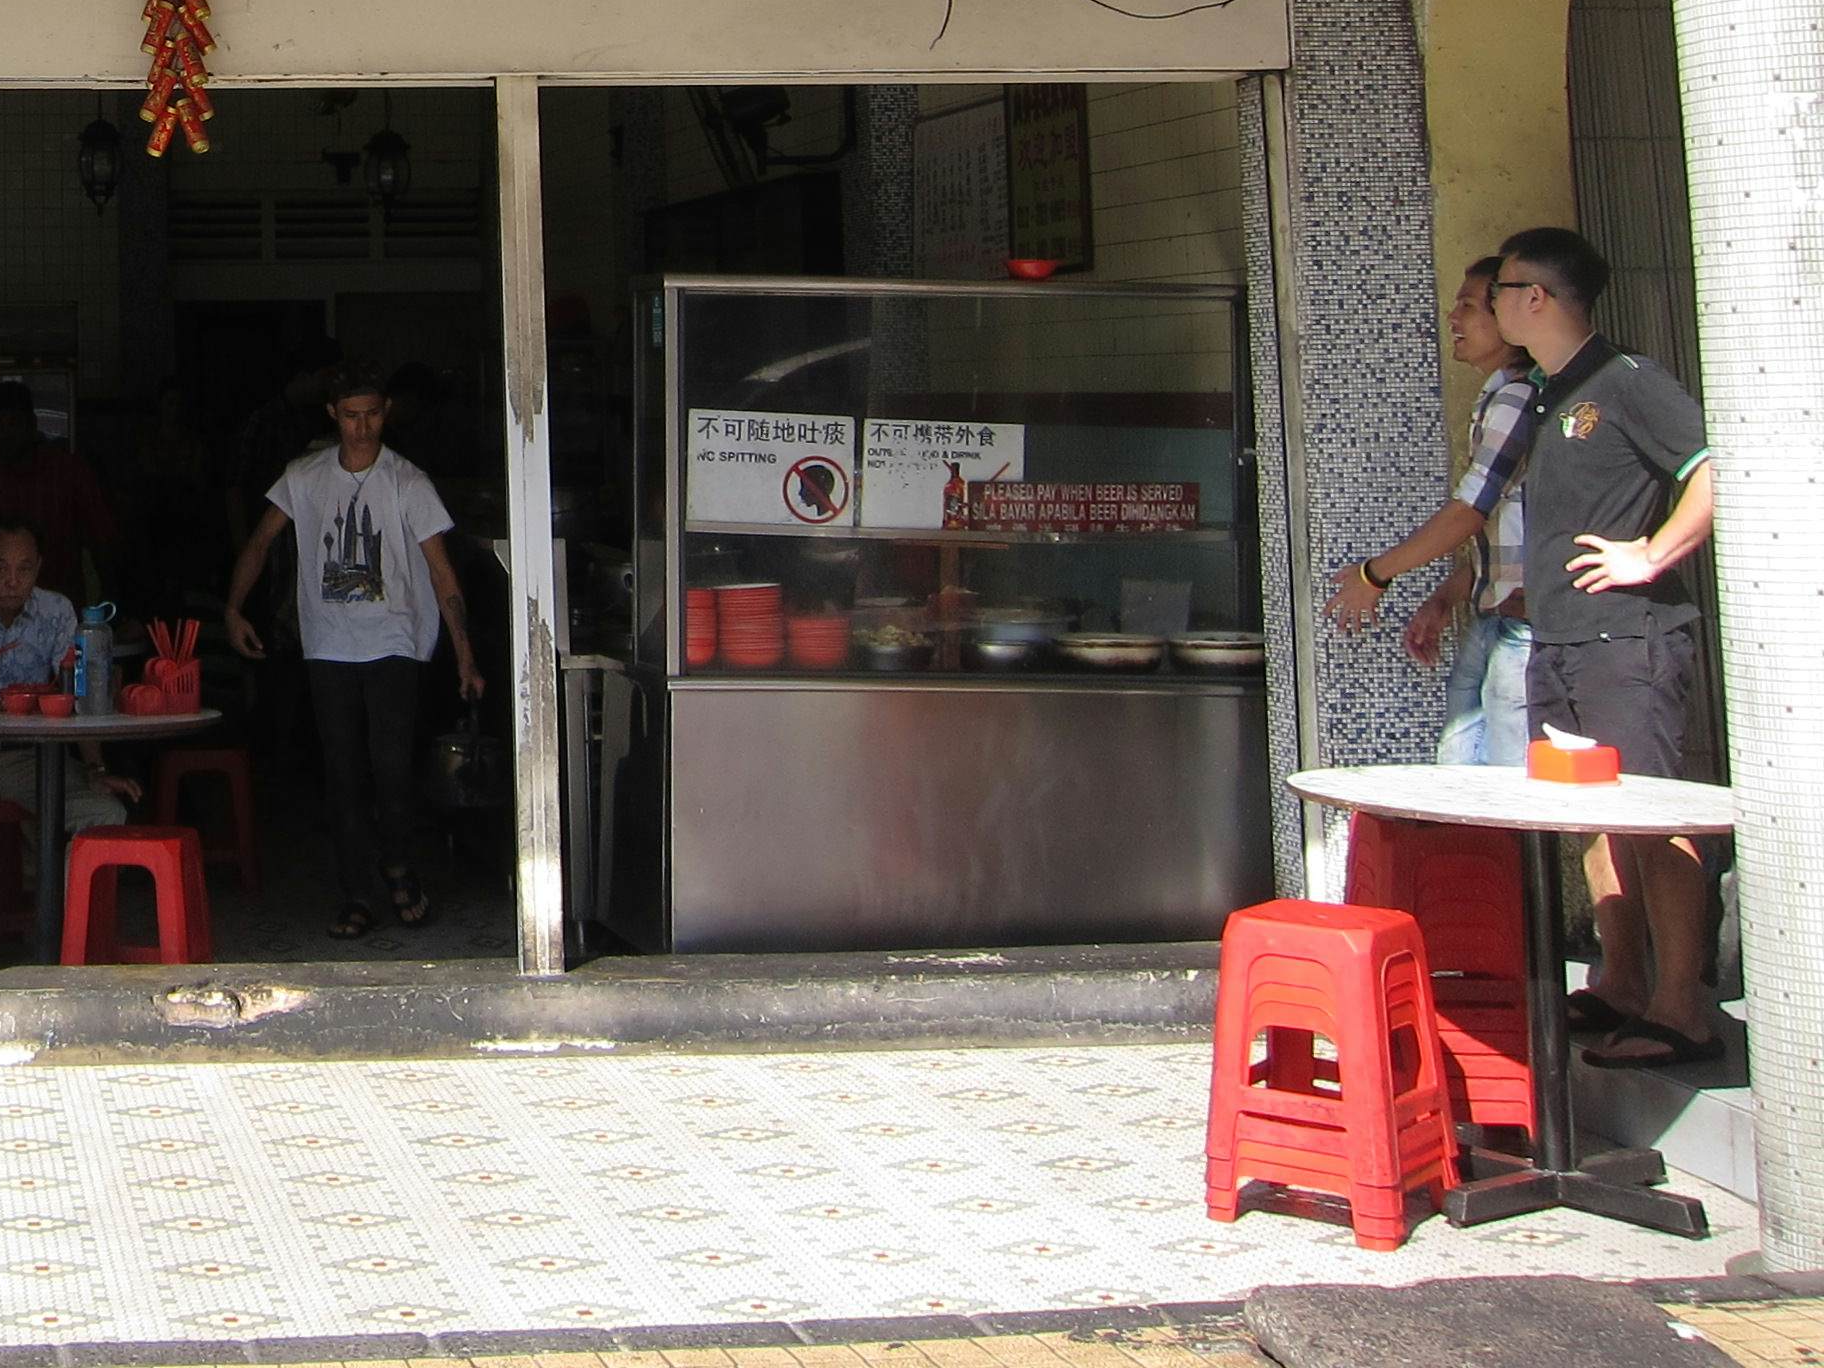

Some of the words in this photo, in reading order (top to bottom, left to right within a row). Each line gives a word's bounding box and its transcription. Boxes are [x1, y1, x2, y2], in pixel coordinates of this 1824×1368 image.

[697, 415, 846, 445] 不可随地吐痰
[719, 451, 778, 464] SPITTING
[951, 452, 981, 460] DRINK
[984, 484, 1034, 501] PLEASED
[1037, 484, 1057, 501] PAY
[1060, 484, 1093, 501] WHEN
[1096, 485, 1125, 501] BEER
[1126, 485, 1138, 501] IS
[1140, 485, 1183, 501] SERVED
[971, 503, 995, 520] SILA
[1000, 503, 1036, 521] BAYAR
[1038, 504, 1086, 521] APABILA
[1089, 504, 1119, 521] BEER
